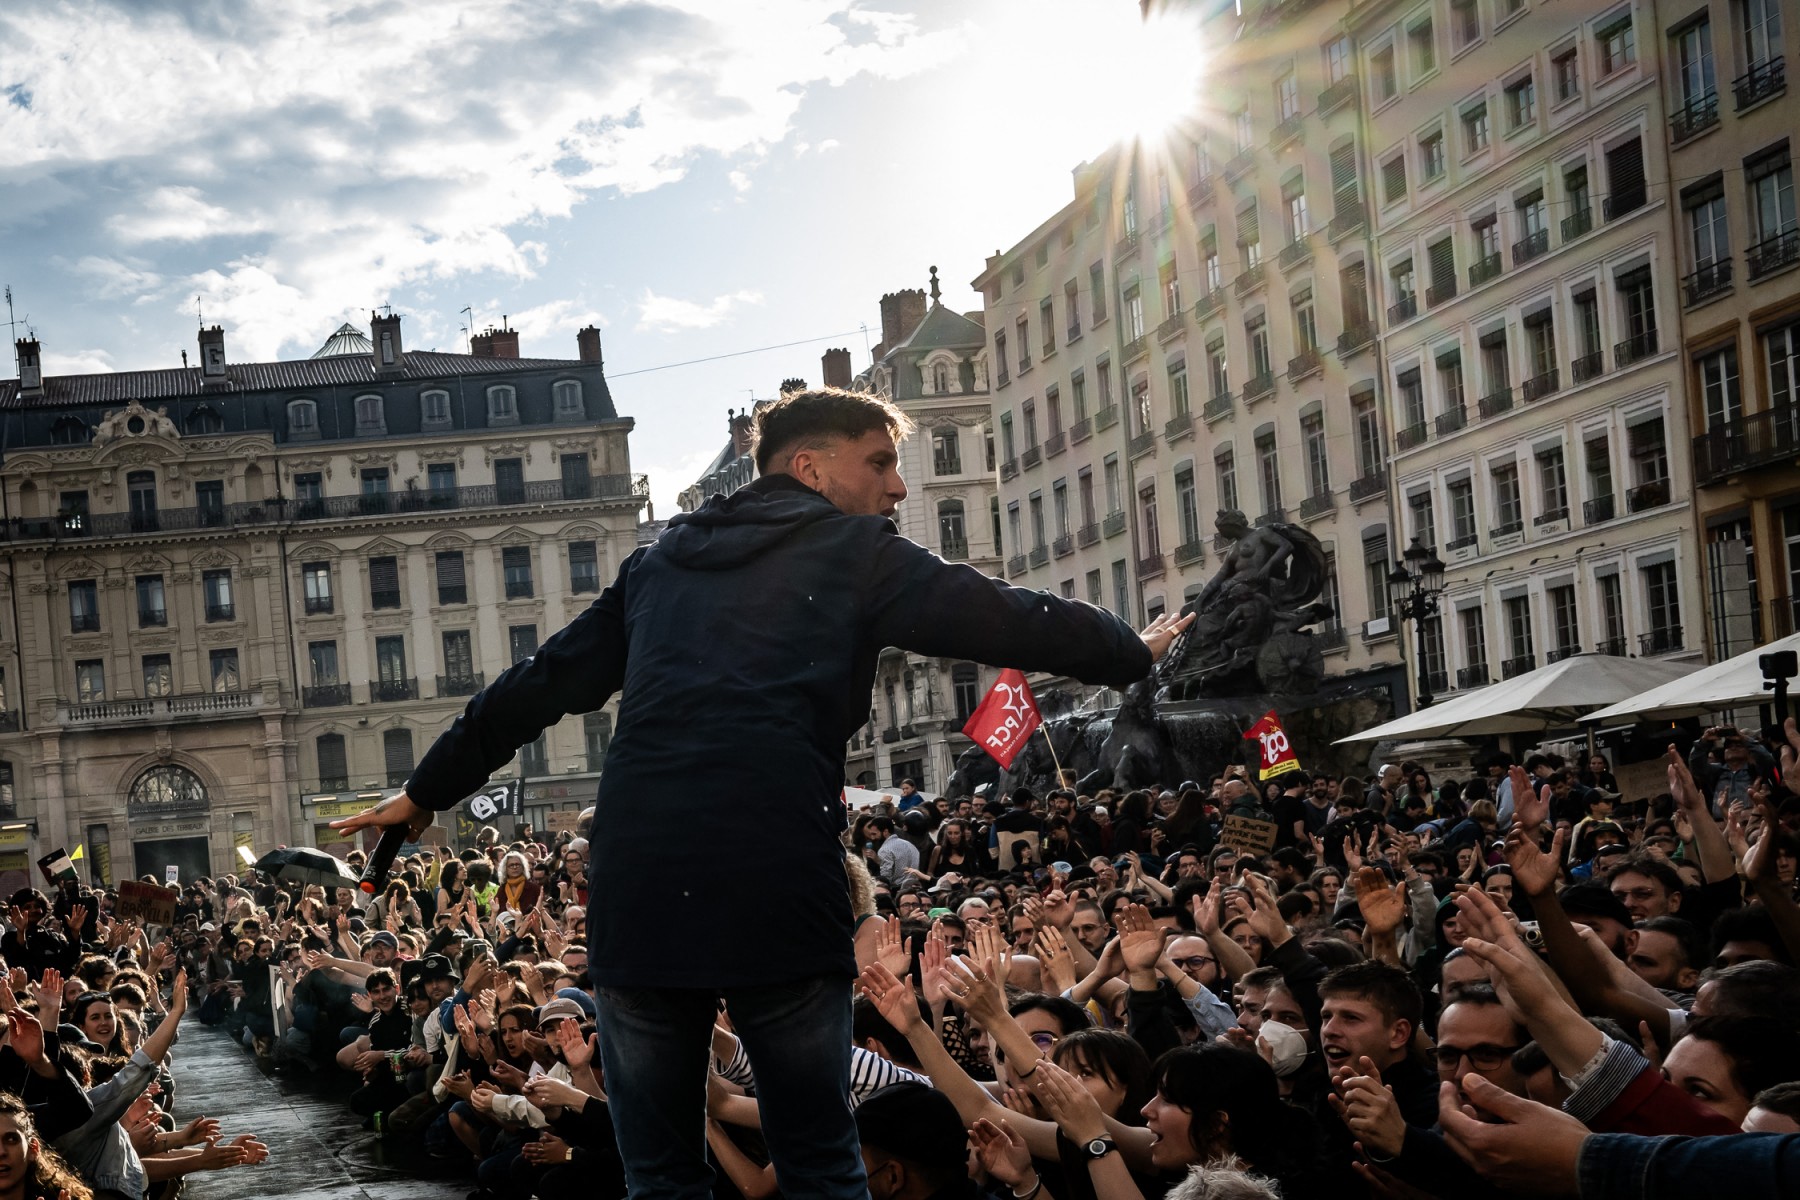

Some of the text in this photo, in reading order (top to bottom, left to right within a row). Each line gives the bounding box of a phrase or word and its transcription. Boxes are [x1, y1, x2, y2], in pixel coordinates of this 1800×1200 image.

[135, 823, 204, 835] GALERIE DES TERREAUX
